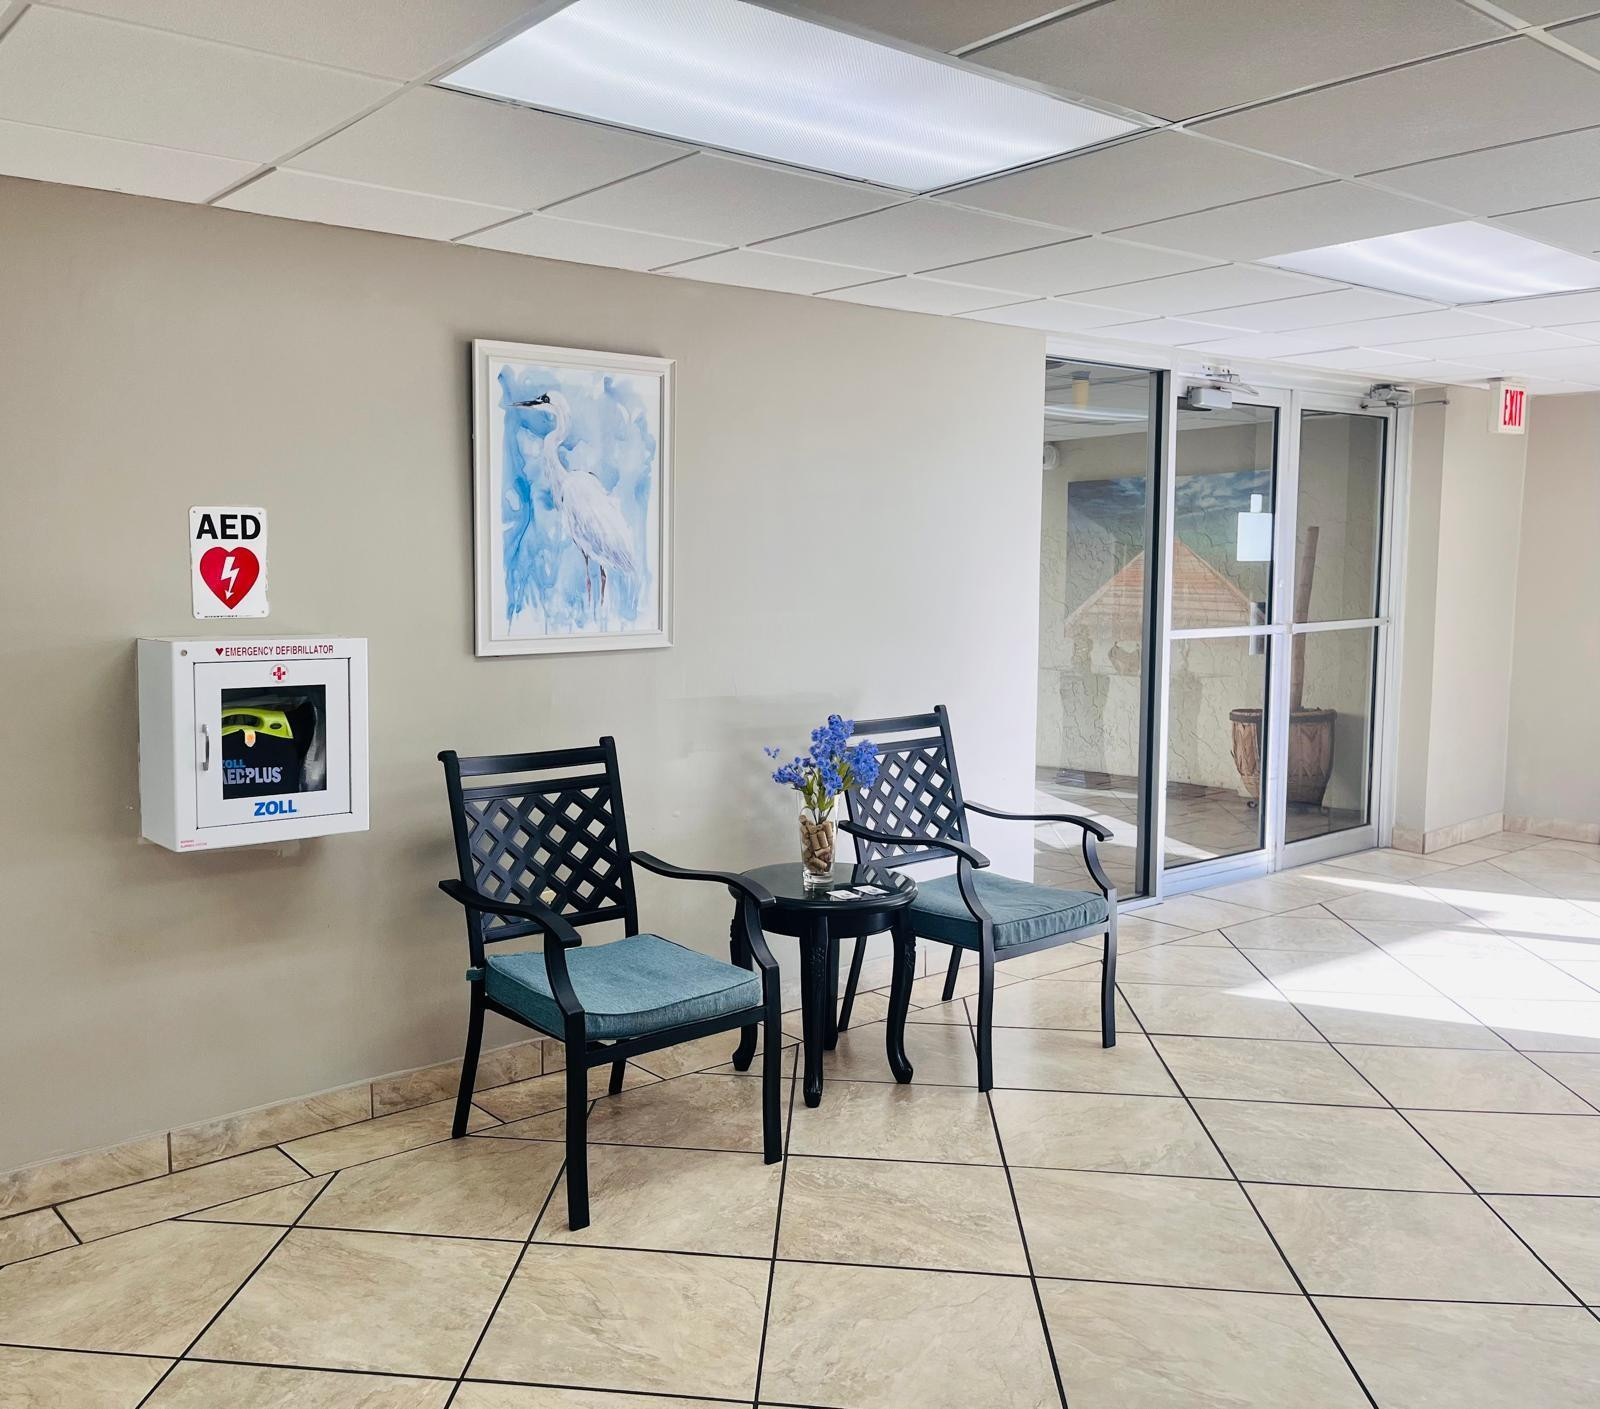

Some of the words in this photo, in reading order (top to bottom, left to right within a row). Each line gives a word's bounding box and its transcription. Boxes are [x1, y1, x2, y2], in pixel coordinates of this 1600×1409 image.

[1503, 389, 1524, 427] EXIT
[196, 513, 261, 540] AED
[225, 646, 274, 656] EMERGENCY
[275, 645, 334, 655] DEFIBRILLATOR
[222, 759, 246, 768] OLL
[253, 799, 297, 817] ZOLL
